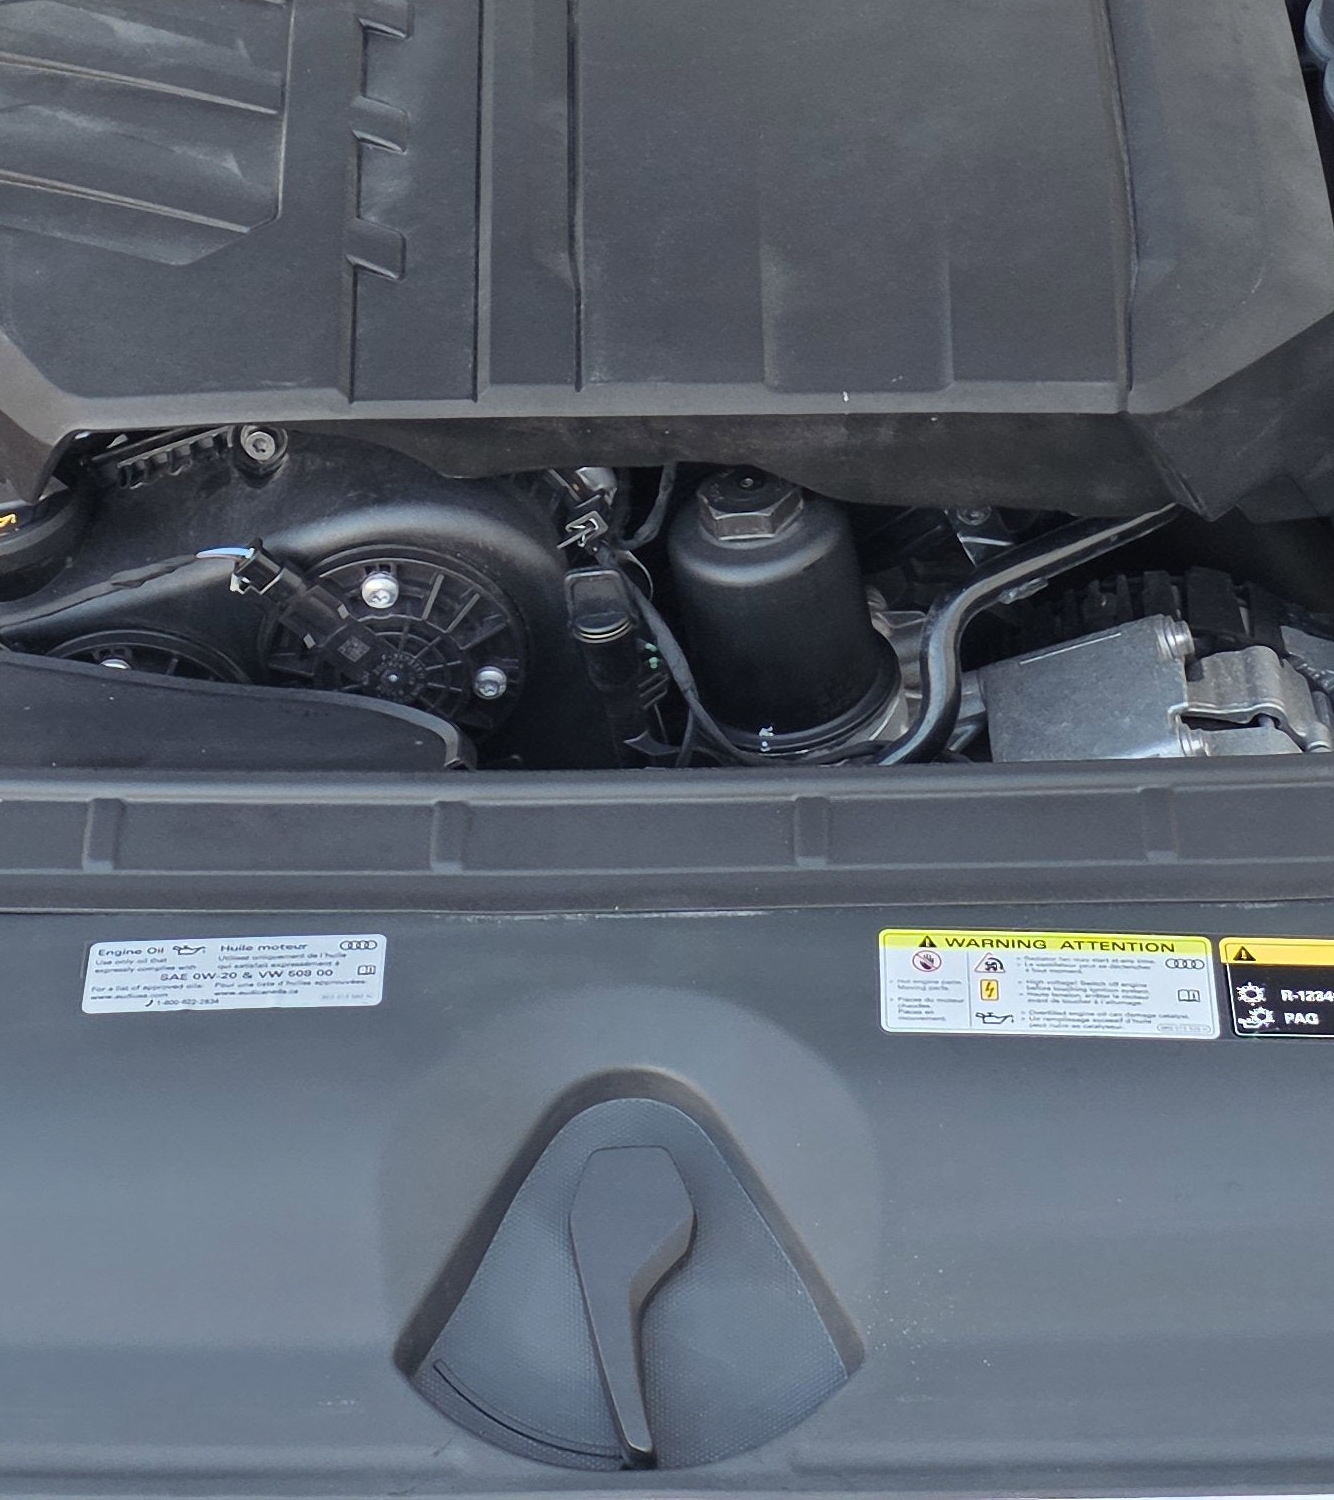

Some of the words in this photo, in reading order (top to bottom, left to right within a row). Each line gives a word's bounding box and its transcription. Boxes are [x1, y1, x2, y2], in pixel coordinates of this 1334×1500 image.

[220, 944, 254, 952] Huile
[945, 937, 1047, 950] WARNING
[1060, 940, 1176, 953] ATTENTION
[98, 948, 142, 957] Engine
[147, 947, 164, 955] Oil
[160, 973, 188, 981] SAE
[192, 972, 237, 980] 0W-20
[242, 971, 253, 979] &
[259, 970, 285, 979] VW
[316, 969, 334, 977] 00
[1284, 1012, 1320, 1025] PAG
